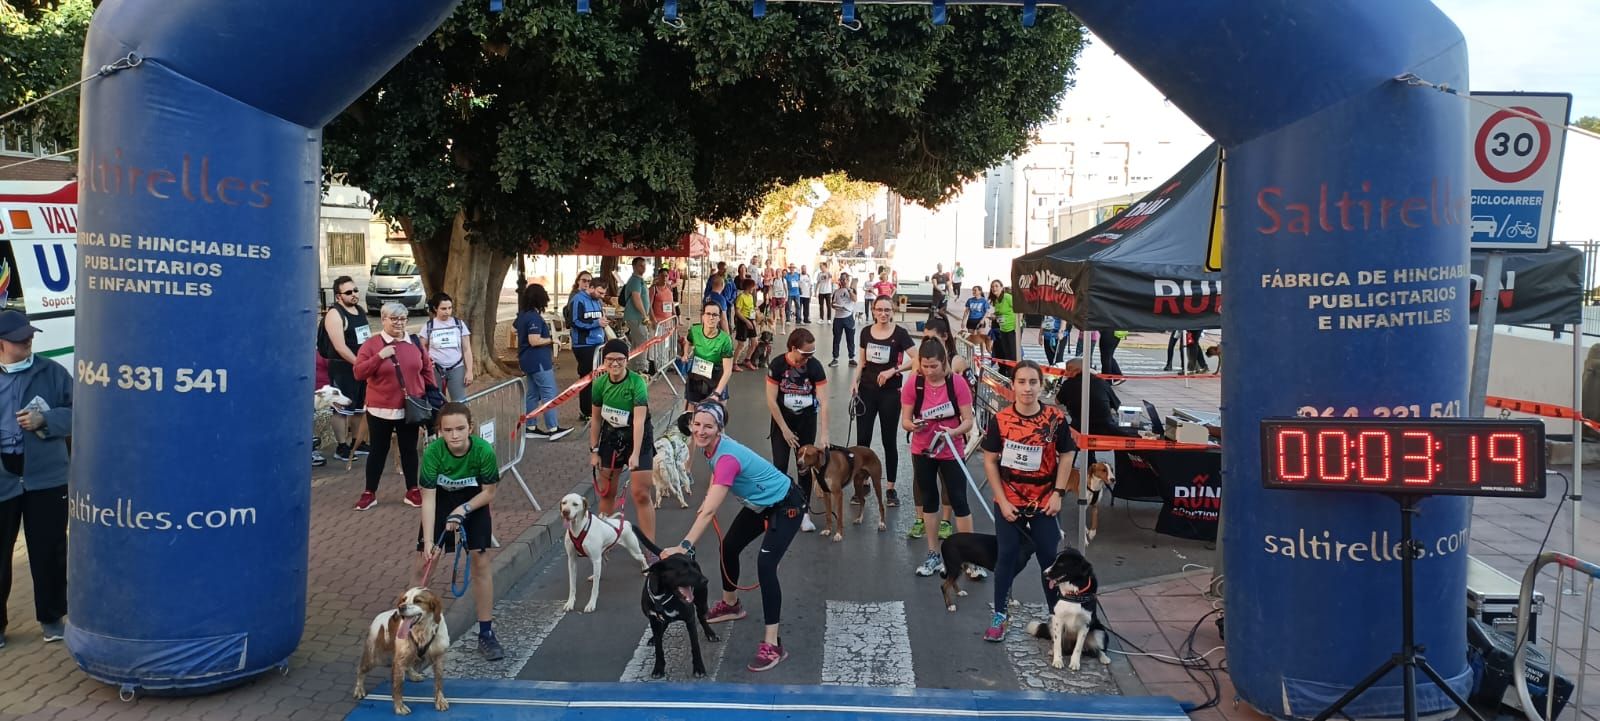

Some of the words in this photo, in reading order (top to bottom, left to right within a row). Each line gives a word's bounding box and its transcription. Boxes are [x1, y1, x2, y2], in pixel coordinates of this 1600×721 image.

[1491, 132, 1534, 157] 30
[1471, 195, 1543, 206] CICLOCARRER
[109, 233, 132, 248] DE
[137, 236, 272, 260] HINCHABLES
[84, 255, 223, 278] PUBLICITARIOS
[89, 276, 96, 290] E
[100, 276, 214, 297] INFANTILES
[1261, 269, 1351, 289] FÁBRICA
[1358, 270, 1387, 286] DE
[42, 294, 76, 309] Soport
[1308, 286, 1457, 310] PUBLICITARIOS
[1318, 315, 1333, 331] E
[1339, 308, 1452, 330] INFANTILES
[77, 359, 111, 388] 964
[117, 364, 164, 391] 331
[174, 368, 228, 393] 541
[1015, 453, 1029, 462] 35
[1278, 430, 1524, 485] 00:03:19
